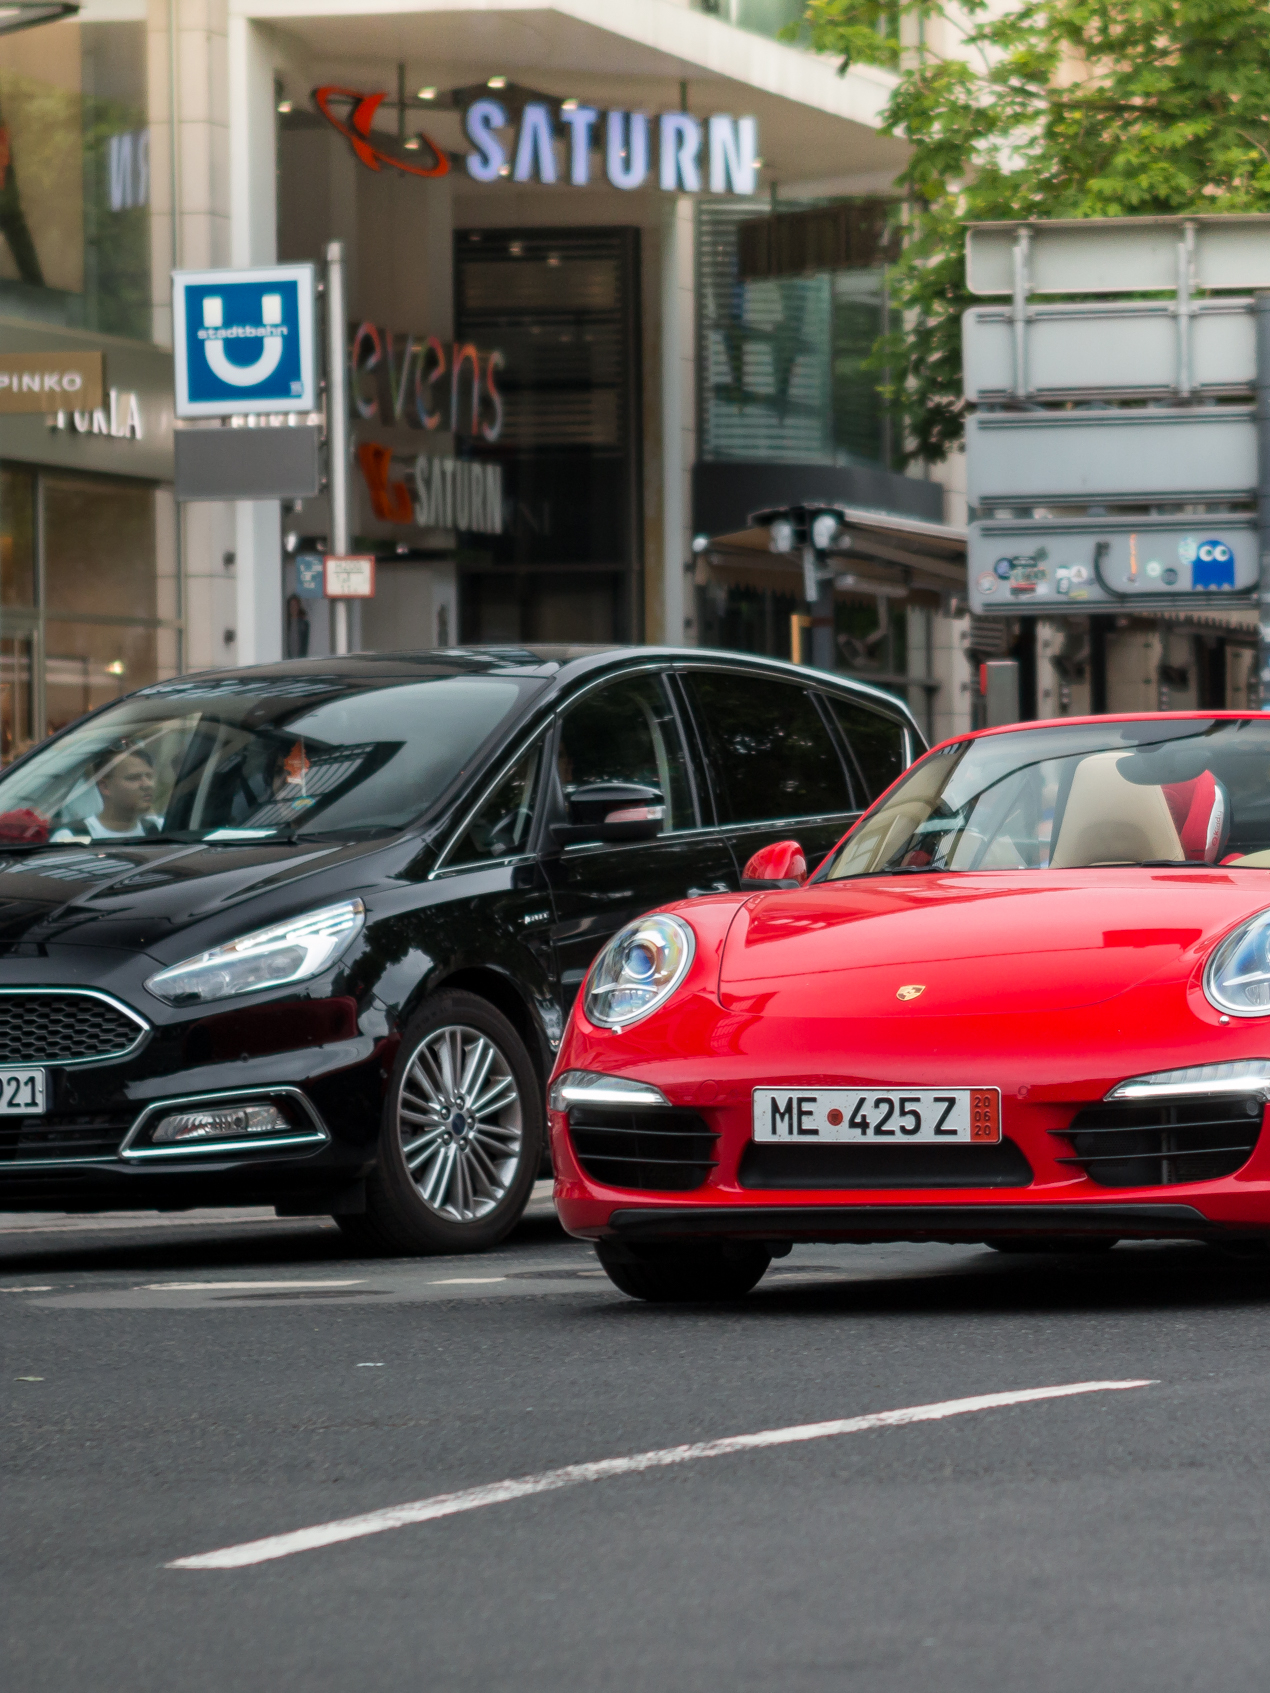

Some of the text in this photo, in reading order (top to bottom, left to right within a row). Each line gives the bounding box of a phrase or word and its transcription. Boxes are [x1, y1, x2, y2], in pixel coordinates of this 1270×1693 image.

[466, 98, 758, 195] SATURN
[197, 325, 288, 340] stadtbahn
[0, 371, 82, 392] PINKO
[415, 453, 503, 534] SATURN
[974, 1095, 991, 1108] 20
[770, 1096, 958, 1136] ME 425 Z
[974, 1109, 991, 1122] 06
[974, 1123, 992, 1136] 20
